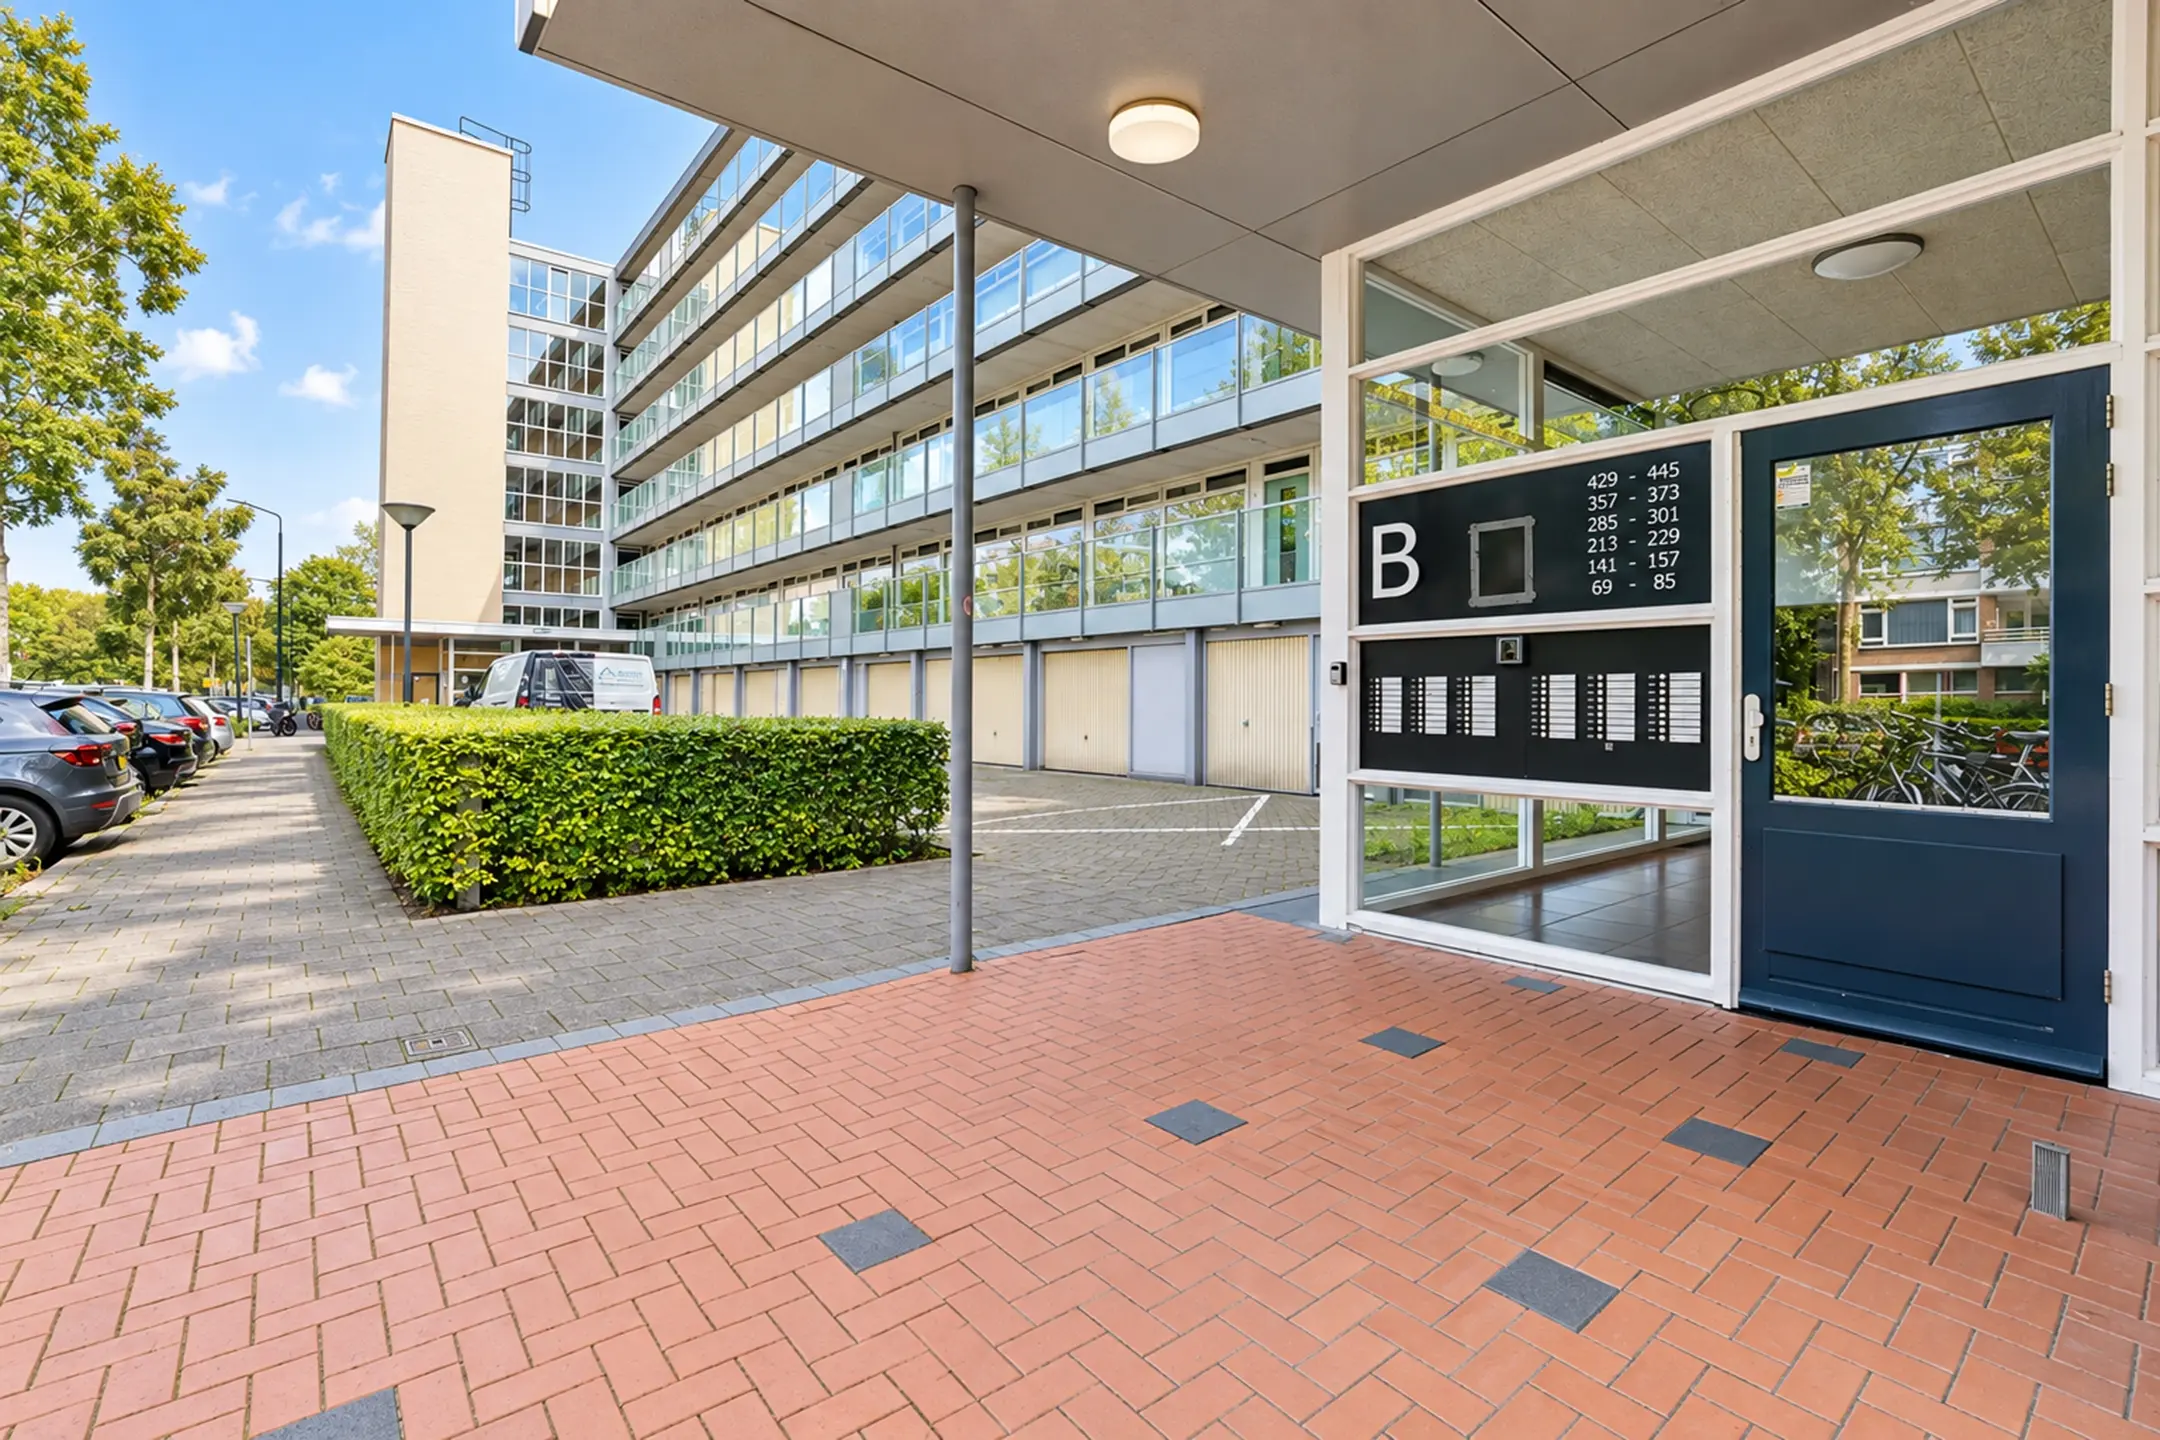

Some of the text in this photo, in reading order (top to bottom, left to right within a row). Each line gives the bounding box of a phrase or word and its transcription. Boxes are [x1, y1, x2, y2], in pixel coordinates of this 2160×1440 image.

[1587, 472, 1618, 489] 429
[1647, 462, 1680, 480] 445
[1587, 493, 1618, 511] 357
[1647, 484, 1680, 502] 373
[1587, 514, 1618, 532] 285
[1647, 506, 1679, 524] 301
[1587, 536, 1618, 553] 213
[1647, 528, 1680, 546] 229
[1373, 522, 1420, 599] B
[1588, 558, 1617, 574] 141
[1648, 550, 1680, 568] 157
[1591, 578, 1612, 595] 69
[1653, 573, 1676, 589] 85
